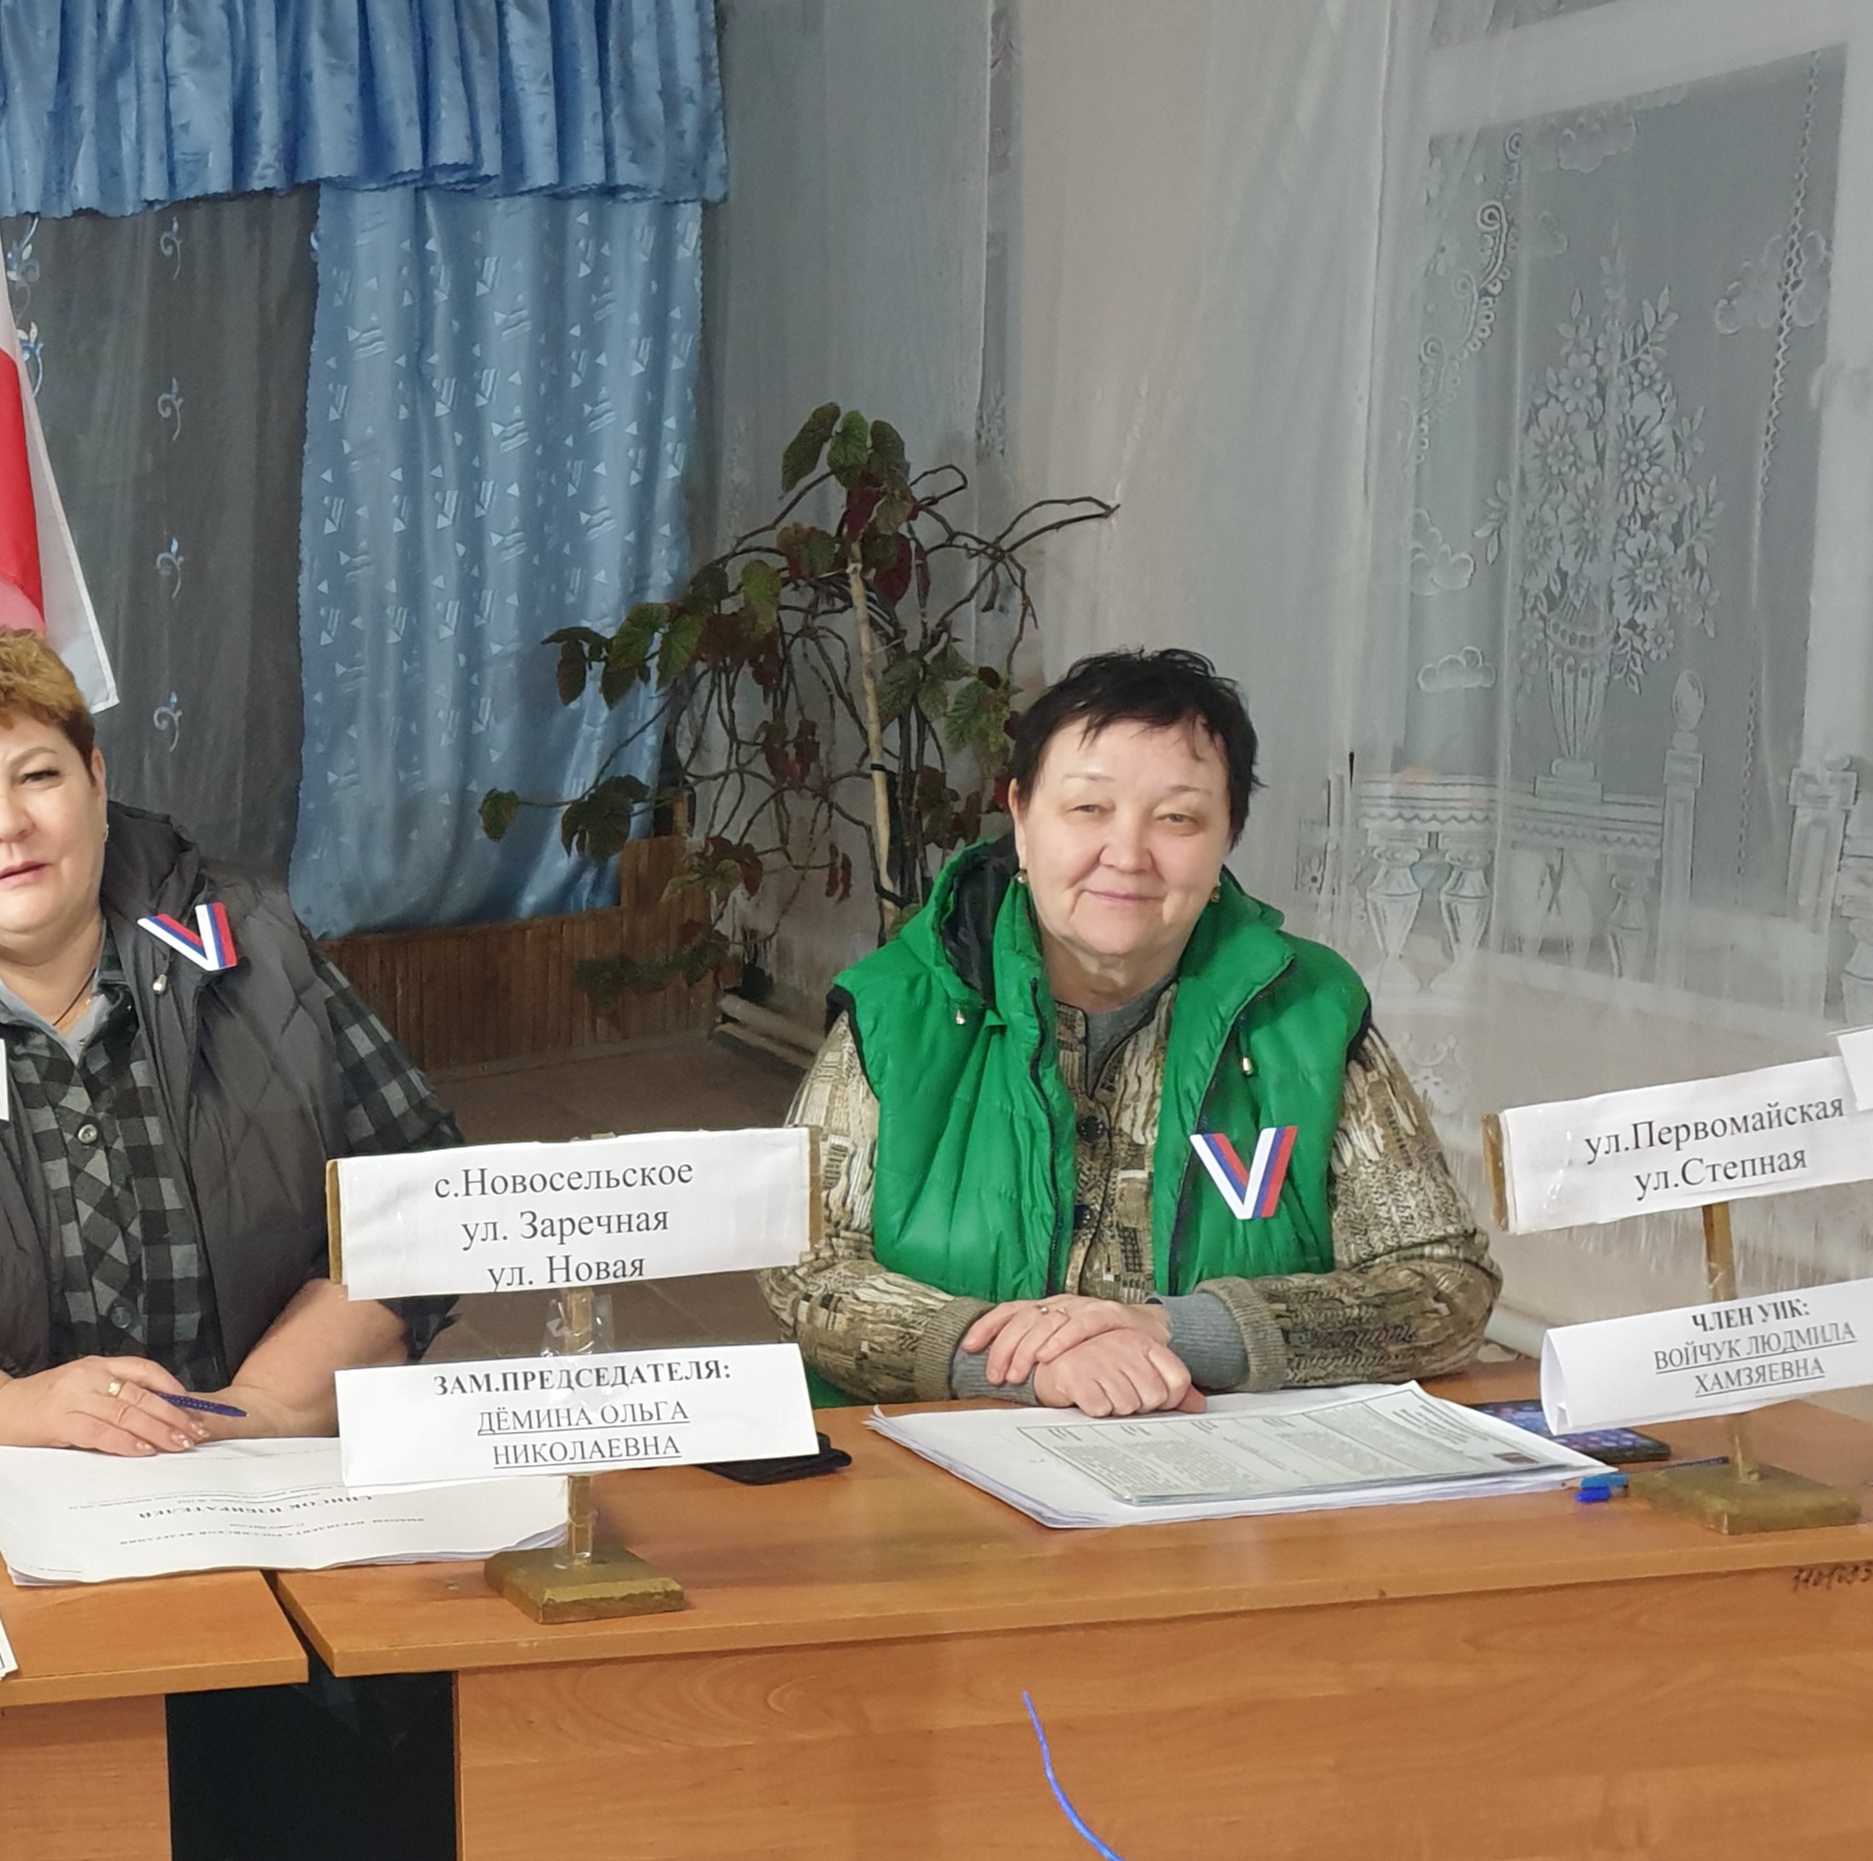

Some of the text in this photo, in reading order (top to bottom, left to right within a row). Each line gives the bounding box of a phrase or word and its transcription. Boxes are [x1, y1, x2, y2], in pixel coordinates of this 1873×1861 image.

[1584, 1098, 1845, 1164] ул.Первомайская
[434, 1162, 694, 1199] с.Новосельское
[1634, 1149, 1808, 1201] ул.Степная
[461, 1207, 669, 1251] ул. Заречная
[487, 1254, 646, 1292] ул. Новая
[1691, 1299, 1810, 1332] ЧЛЕН УИК:
[1654, 1322, 1856, 1370] ВОЙЧУК ЛЮДМИЛА
[433, 1360, 731, 1396] ЗАМ.ПРЕДСЕДАТЕЛЯ:
[1695, 1357, 1825, 1394] ХАМЗЯЕВНА
[478, 1400, 689, 1435] ДЁМИНА ОЛЬГА
[493, 1435, 681, 1466] НИКОЛАЕВНА
